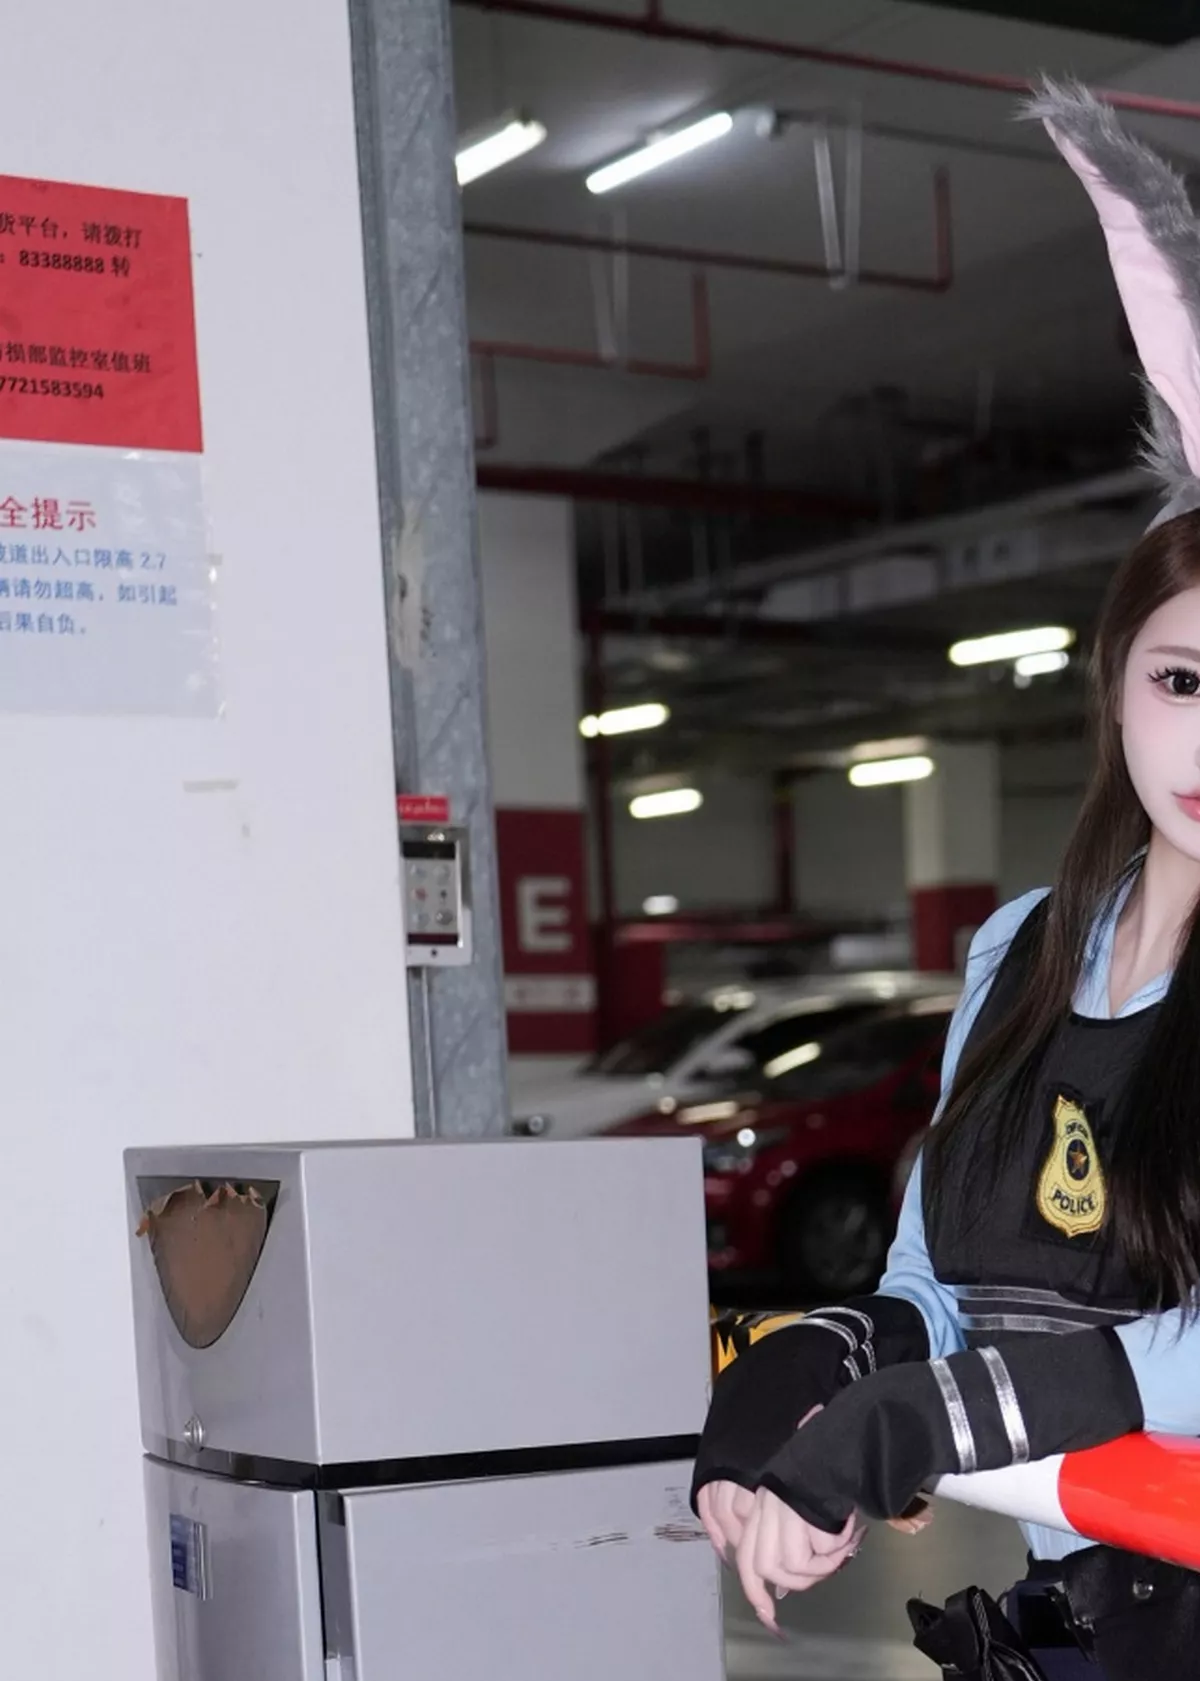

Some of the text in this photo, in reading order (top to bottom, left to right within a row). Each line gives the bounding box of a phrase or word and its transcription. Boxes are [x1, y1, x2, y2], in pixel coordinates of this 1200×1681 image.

[0, 341, 150, 373] 损部监控室值班
[0, 496, 97, 531] 全提示
[516, 875, 573, 952] E
[1051, 1189, 1096, 1214] POLICE
